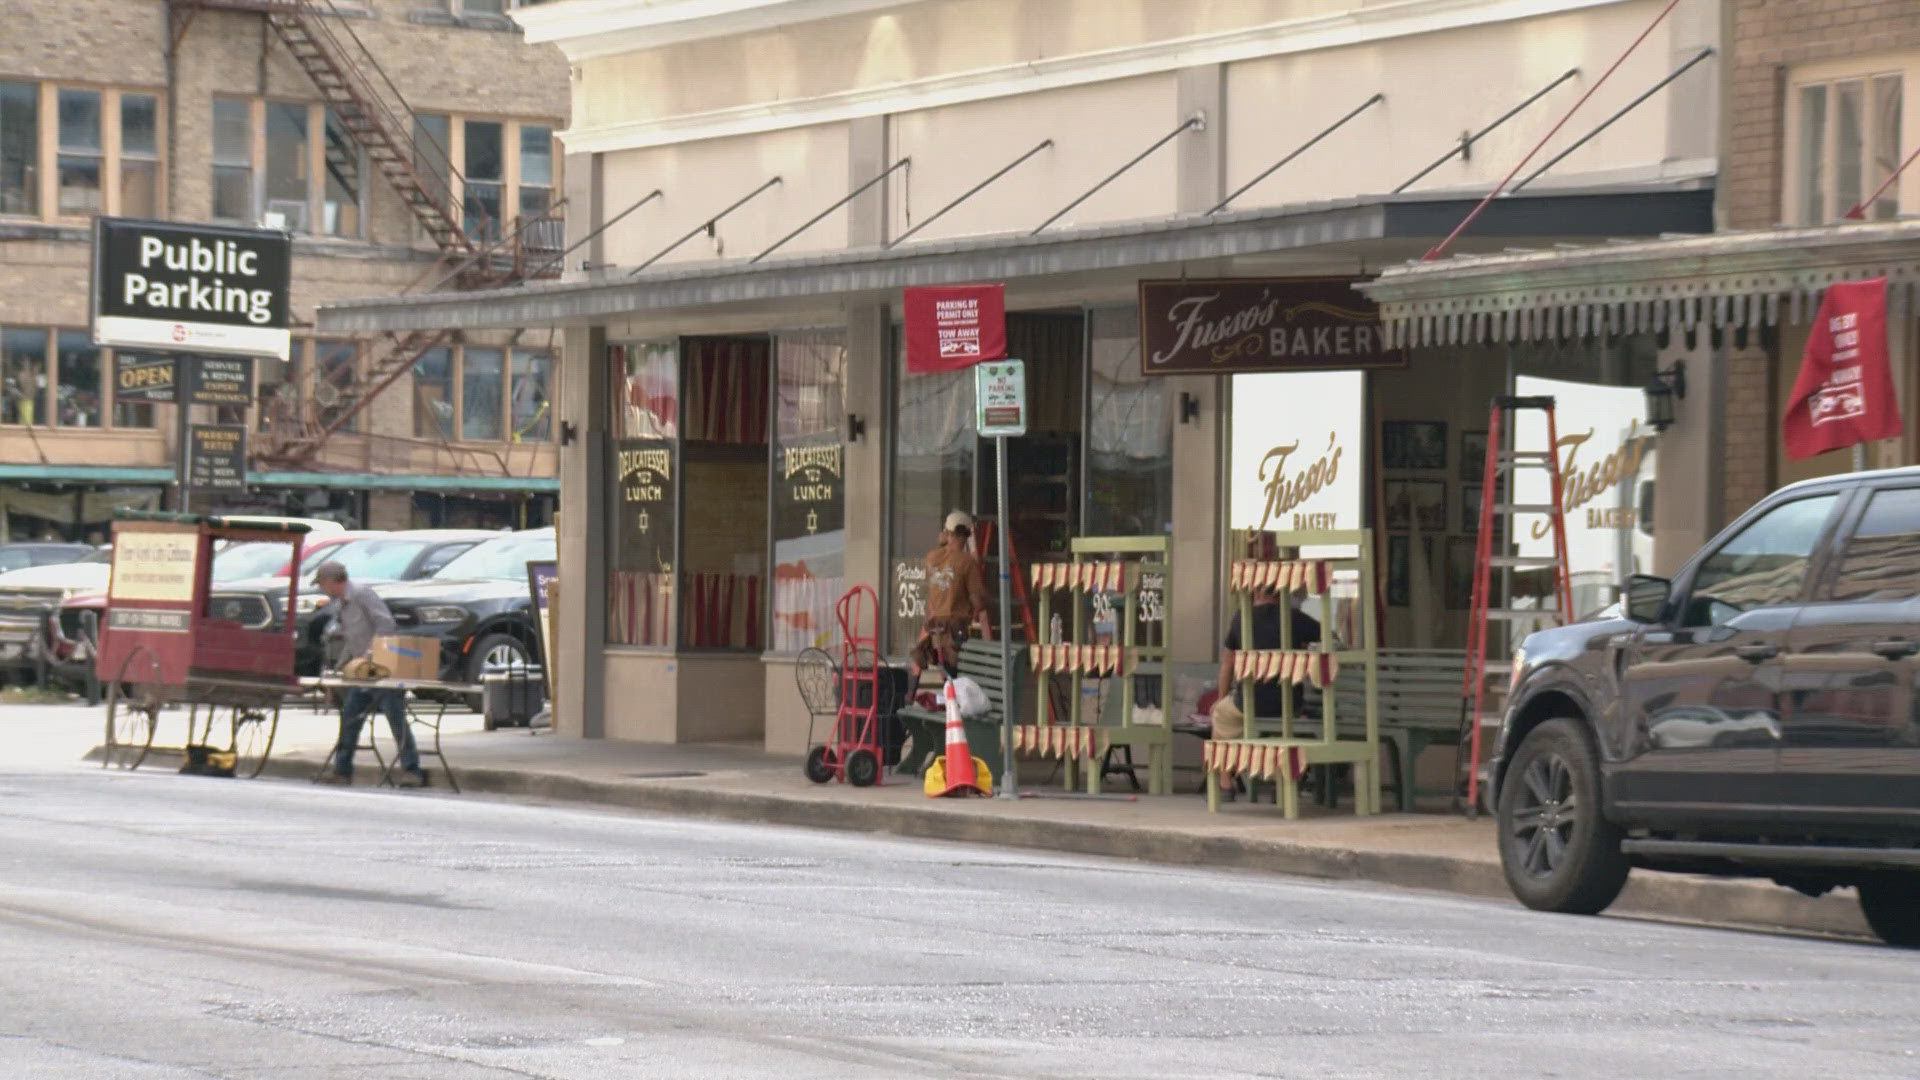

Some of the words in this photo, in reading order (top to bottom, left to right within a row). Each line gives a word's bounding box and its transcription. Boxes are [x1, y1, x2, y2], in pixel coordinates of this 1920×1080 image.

[140, 235, 258, 276] Public
[124, 272, 272, 324] Parking
[936, 301, 967, 311] PARKING
[968, 299, 978, 308] BY
[936, 310, 961, 321] PERMIT
[961, 309, 979, 318] ONLY
[1152, 288, 1278, 364] Fusso's
[938, 330, 956, 339] TOW
[957, 328, 980, 338] AWAY
[120, 365, 174, 389] OPEN
[619, 449, 670, 482] DELICATESSEN
[785, 445, 841, 480] DELICATESSEN
[626, 486, 662, 501] LUNCH
[793, 484, 832, 500] LUNCH
[1247, 431, 1342, 543] Fusso's
[1293, 512, 1337, 531] BAKERY
